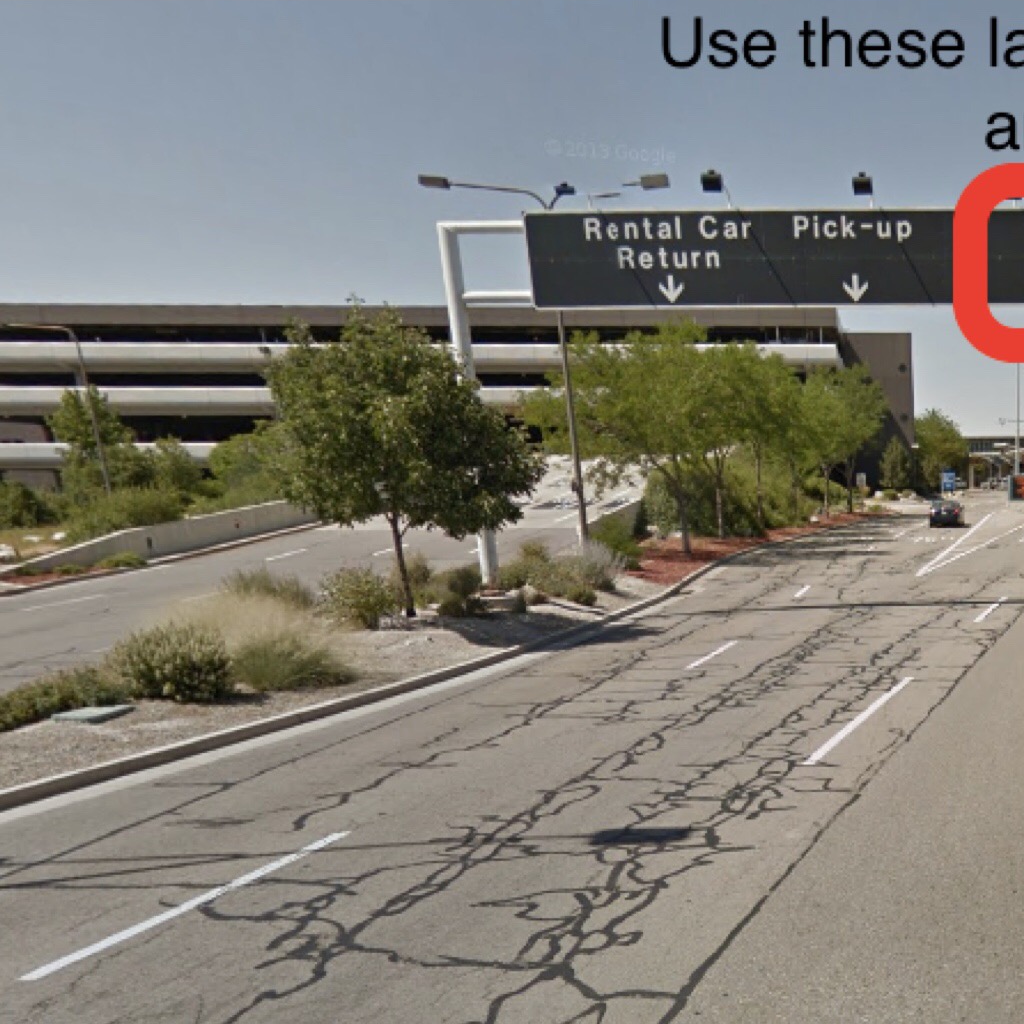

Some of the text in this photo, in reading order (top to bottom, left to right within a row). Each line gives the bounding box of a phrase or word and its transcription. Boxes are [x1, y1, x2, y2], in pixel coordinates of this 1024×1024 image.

[583, 215, 751, 241] Rental Car
[792, 215, 913, 242] Pick-up
[616, 245, 721, 270] Return
